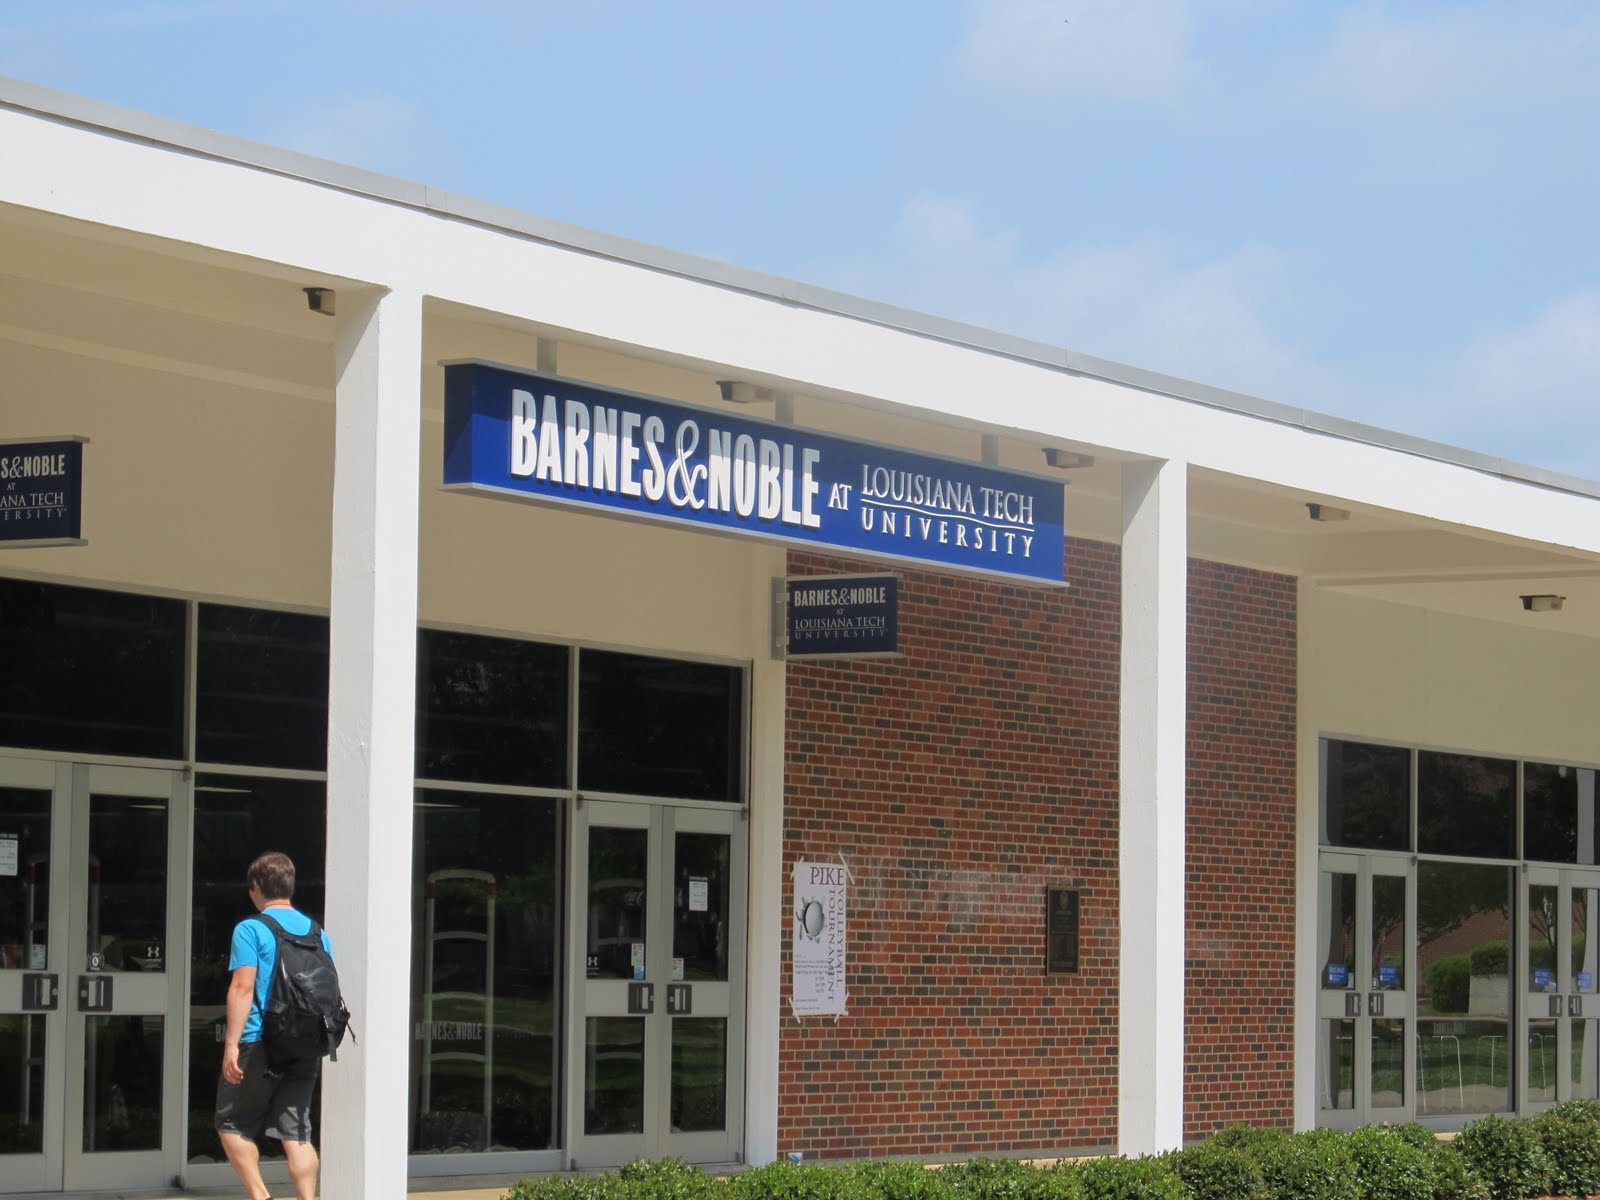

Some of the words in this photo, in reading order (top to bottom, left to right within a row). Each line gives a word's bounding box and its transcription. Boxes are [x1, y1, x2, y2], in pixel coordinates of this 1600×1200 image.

[511, 388, 821, 528] BARNES&NOBLE
[827, 482, 852, 511] AT
[7, 483, 16, 491] AT
[861, 464, 976, 515] LOUISIANA
[980, 486, 1034, 526] TECH
[30, 491, 64, 506] TECH
[861, 507, 1034, 558] UNIVERSITY
[794, 587, 886, 607] BARNES&NOBLE
[795, 618, 853, 630] LOUISIANA
[856, 616, 885, 627] TECH
[795, 629, 885, 639] UNIVERSITY
[809, 866, 844, 886] PIKE
[827, 886, 836, 1004] TOURNAMENT
